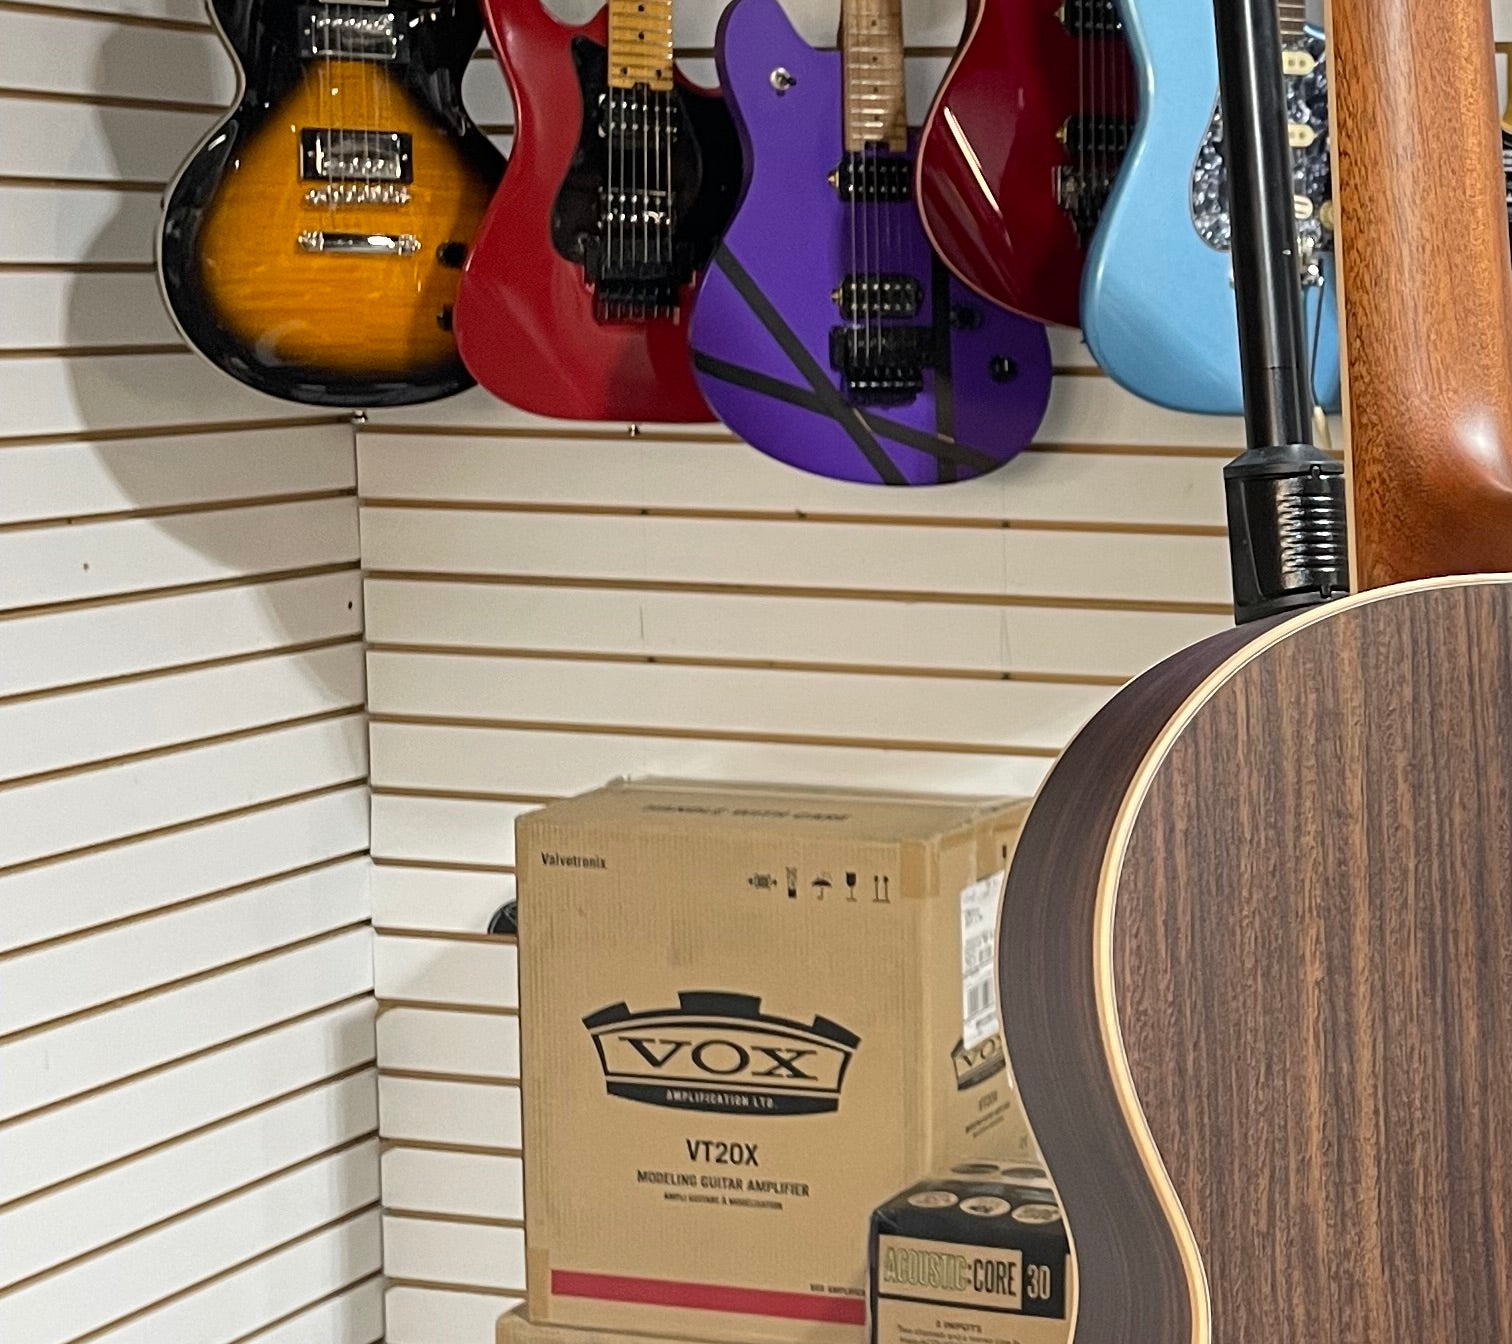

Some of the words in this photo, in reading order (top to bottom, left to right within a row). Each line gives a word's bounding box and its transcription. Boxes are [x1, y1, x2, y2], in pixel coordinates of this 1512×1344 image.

[618, 1036, 819, 1082] VOX
[685, 1137, 760, 1167] VT20X
[636, 1169, 698, 1189] MODELING
[700, 1174, 743, 1193] GUITAR
[747, 1179, 810, 1199] AMPLIFIER
[1027, 1264, 1051, 1300] 30
